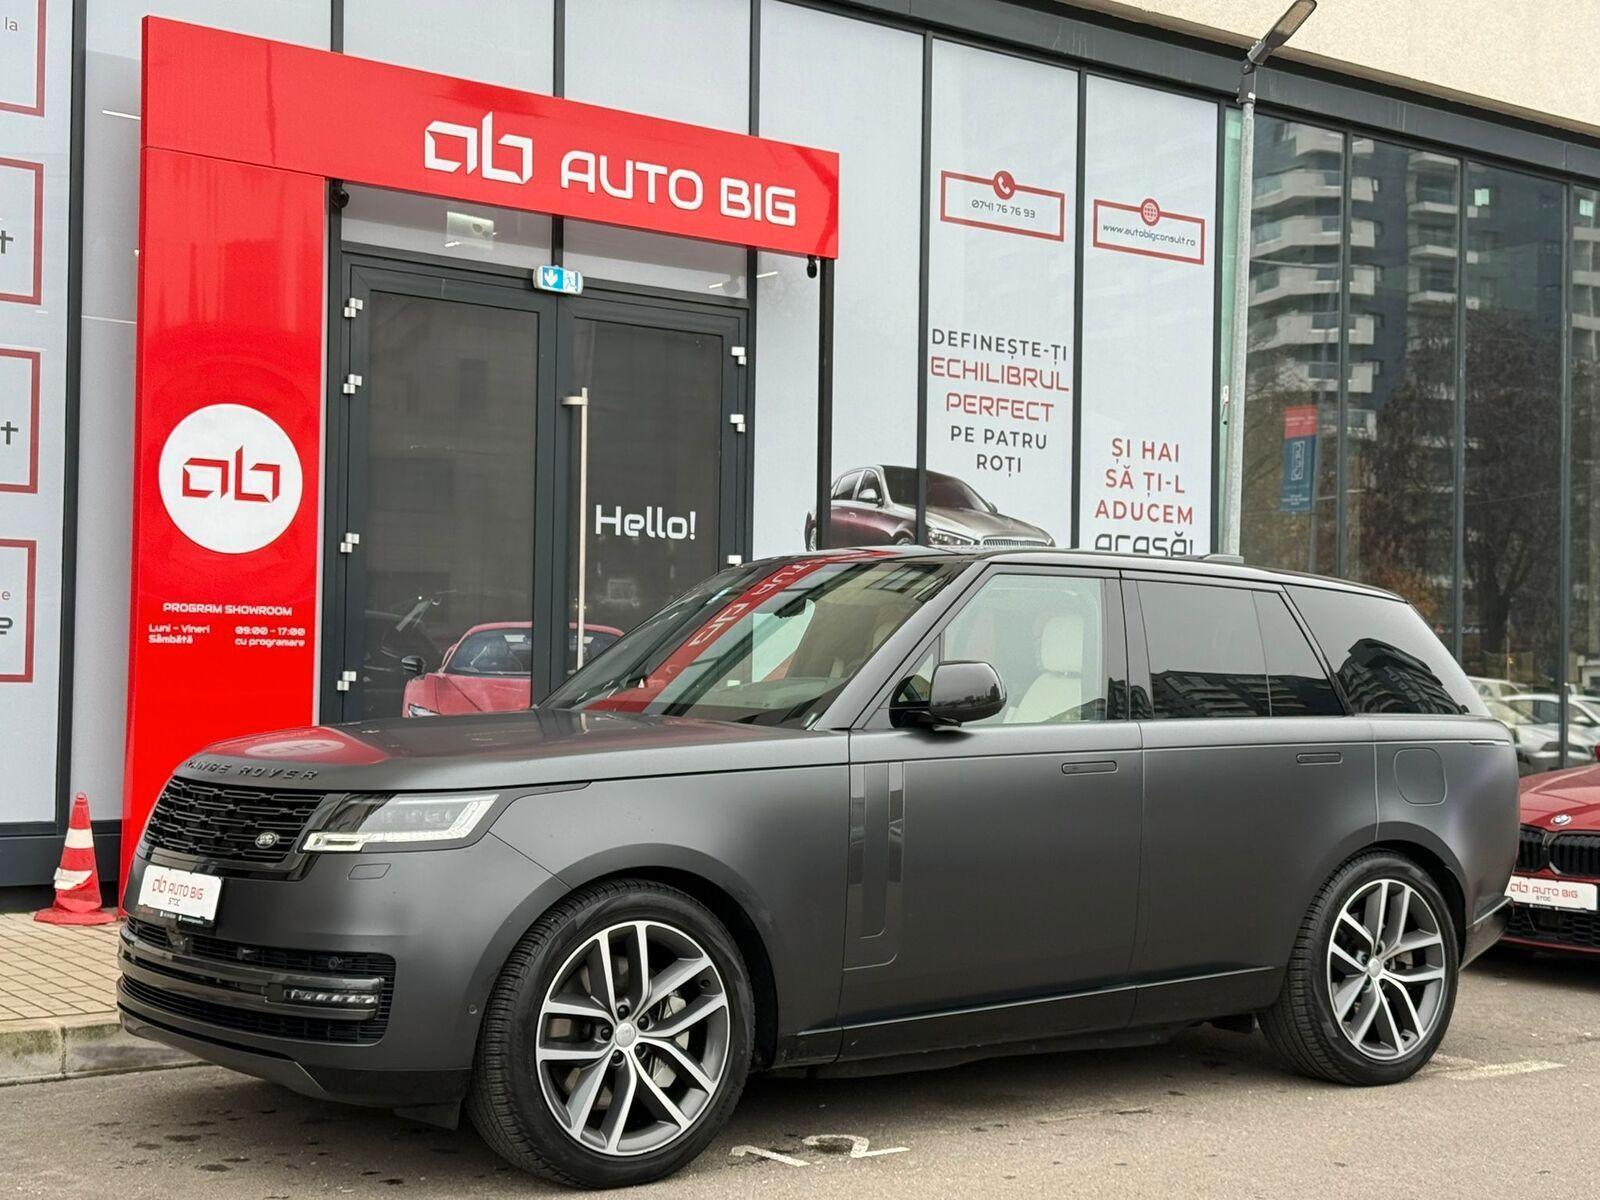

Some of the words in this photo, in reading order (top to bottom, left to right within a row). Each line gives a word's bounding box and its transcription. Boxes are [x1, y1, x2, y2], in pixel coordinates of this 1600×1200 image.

[560, 150, 703, 211] AUTO
[720, 177, 797, 227] BIG
[971, 199, 994, 211] 0741
[996, 203, 1008, 214] 76
[1010, 206, 1021, 216] 76
[1023, 208, 1036, 219] 93
[1102, 224, 1196, 247] www.autobigconsult.ro
[932, 328, 1067, 365] DEFINEȘTE-ȚI
[931, 356, 1069, 392] ECHILIBRUL
[946, 392, 1054, 422] PERFECT
[950, 425, 975, 443] PE
[984, 428, 1047, 450] PATRU
[1111, 437, 1131, 464] ȘI
[1142, 440, 1179, 462] HAI
[976, 453, 1022, 478] ROȚI
[1105, 464, 1134, 490] SĂ
[1143, 471, 1185, 498] ȚI-L
[595, 504, 696, 540] Hello!
[1094, 499, 1193, 525] ADUCEM
[163, 602, 222, 615] PROGRAM
[224, 604, 293, 617] SHOWROOM
[148, 623, 172, 633] Luni
[181, 624, 211, 634] Vineri
[234, 626, 268, 636] 09:00
[277, 626, 306, 637] 17:00
[234, 637, 247, 646] cu
[249, 638, 305, 649] programare
[238, 765, 319, 781] ROVER
[168, 882, 189, 898] AUTO
[190, 886, 204, 901] BIG
[1532, 886, 1559, 897] AUTO
[1561, 888, 1578, 899] BIG
